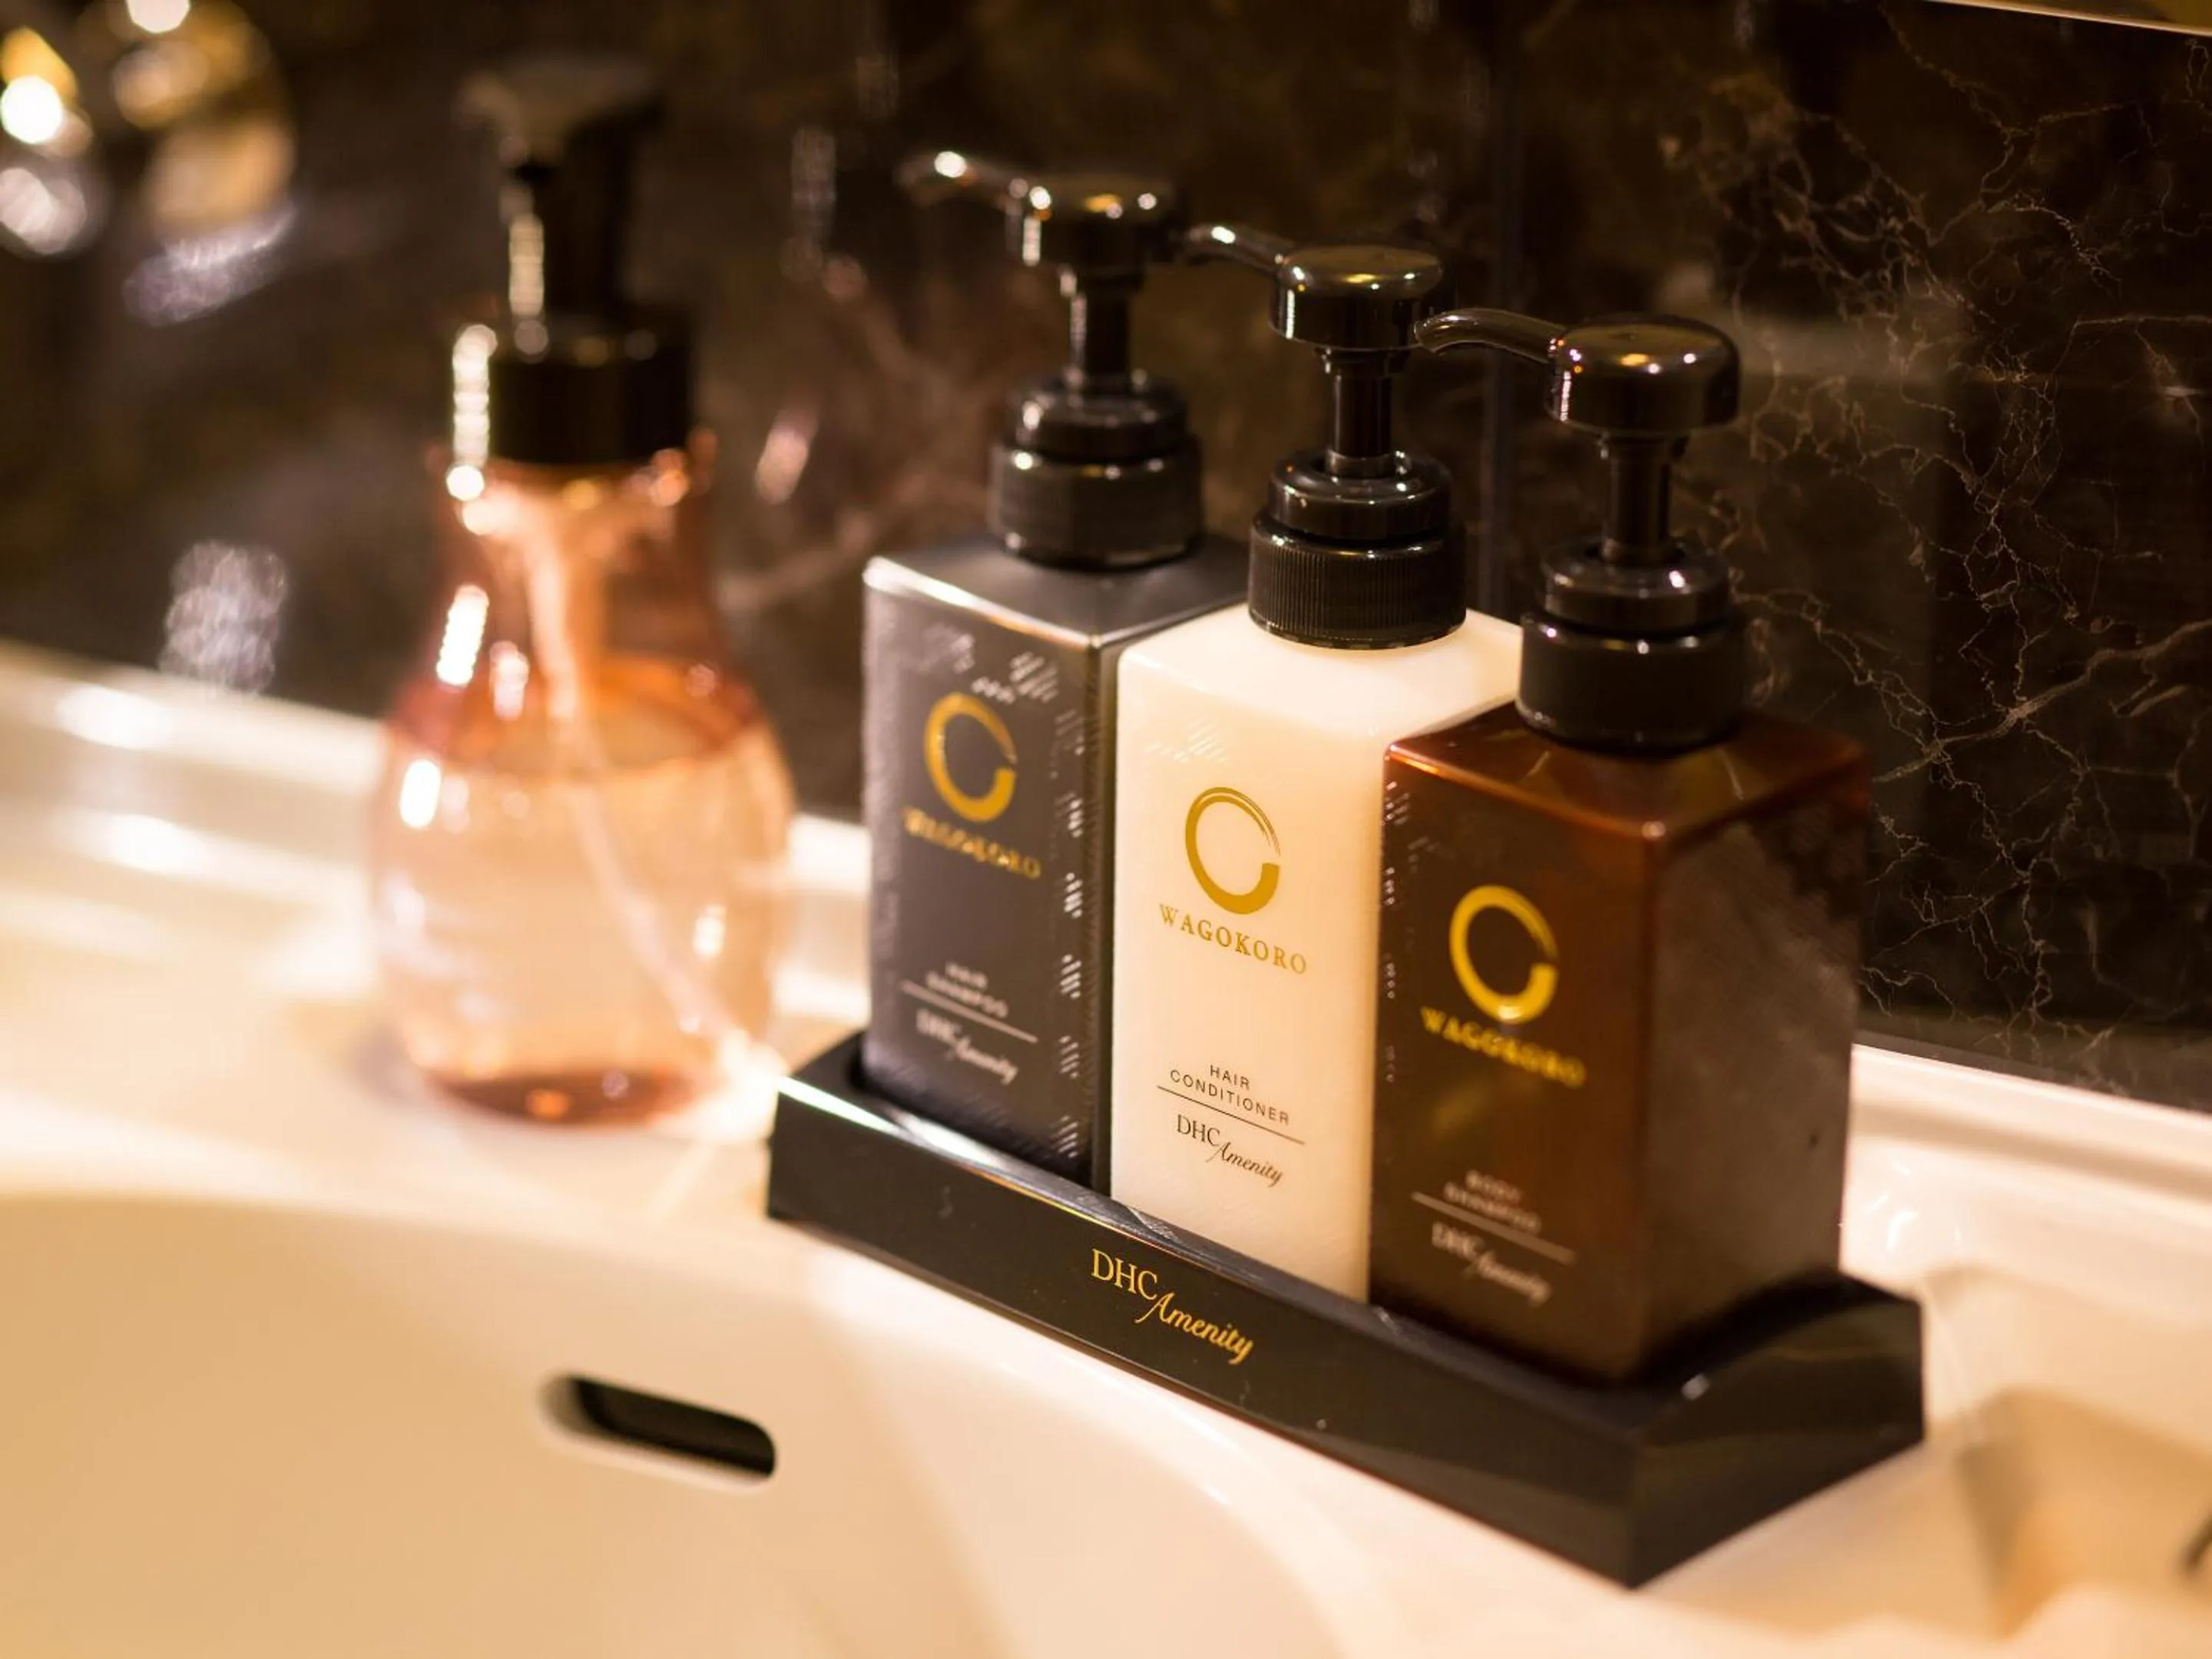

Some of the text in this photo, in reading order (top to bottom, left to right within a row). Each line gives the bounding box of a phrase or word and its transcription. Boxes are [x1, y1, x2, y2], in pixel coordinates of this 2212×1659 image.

[1158, 902, 1307, 975] WAGOKORO
[1170, 1069, 1290, 1125] CONDITIONER
[1210, 1065, 1250, 1091] HAIR
[1177, 1114, 1283, 1188] DHC Amenity
[1091, 1248, 1254, 1366] DHC Amenity
